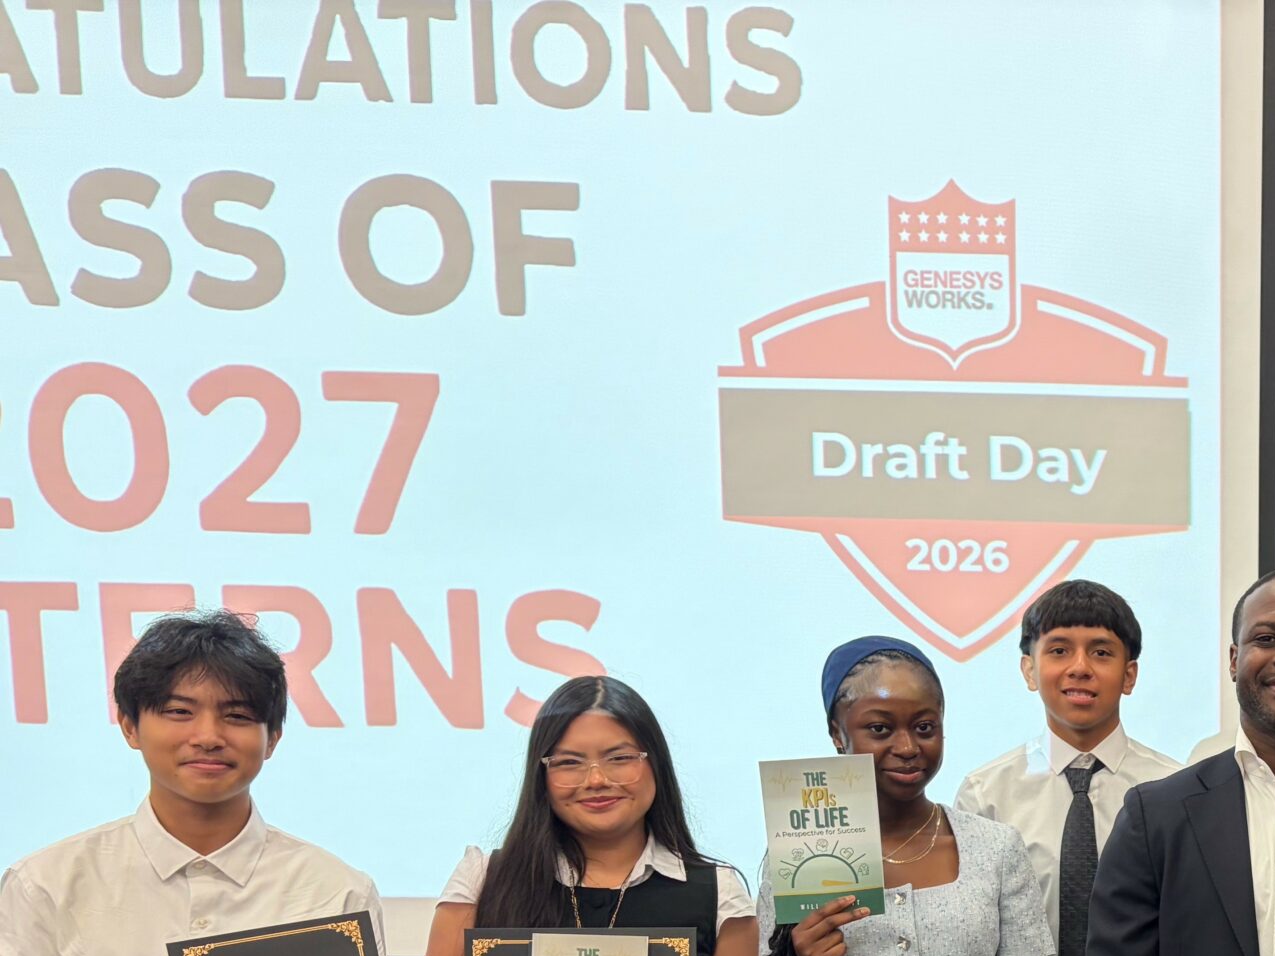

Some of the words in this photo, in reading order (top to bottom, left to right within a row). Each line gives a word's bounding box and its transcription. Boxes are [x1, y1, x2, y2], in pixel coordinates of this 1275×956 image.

[338, 174, 581, 316] OF
[903, 269, 1004, 291] GENESYS
[904, 289, 994, 310] WORKS.
[0, 361, 441, 535] 027
[812, 431, 970, 481] Draft
[989, 435, 1108, 495] Day
[905, 537, 1010, 573] 2026
[803, 771, 827, 786] THE
[790, 809, 811, 830] OF
[815, 806, 850, 829] LIFE
[782, 830, 824, 839] Perspective
[837, 827, 866, 835] Success
